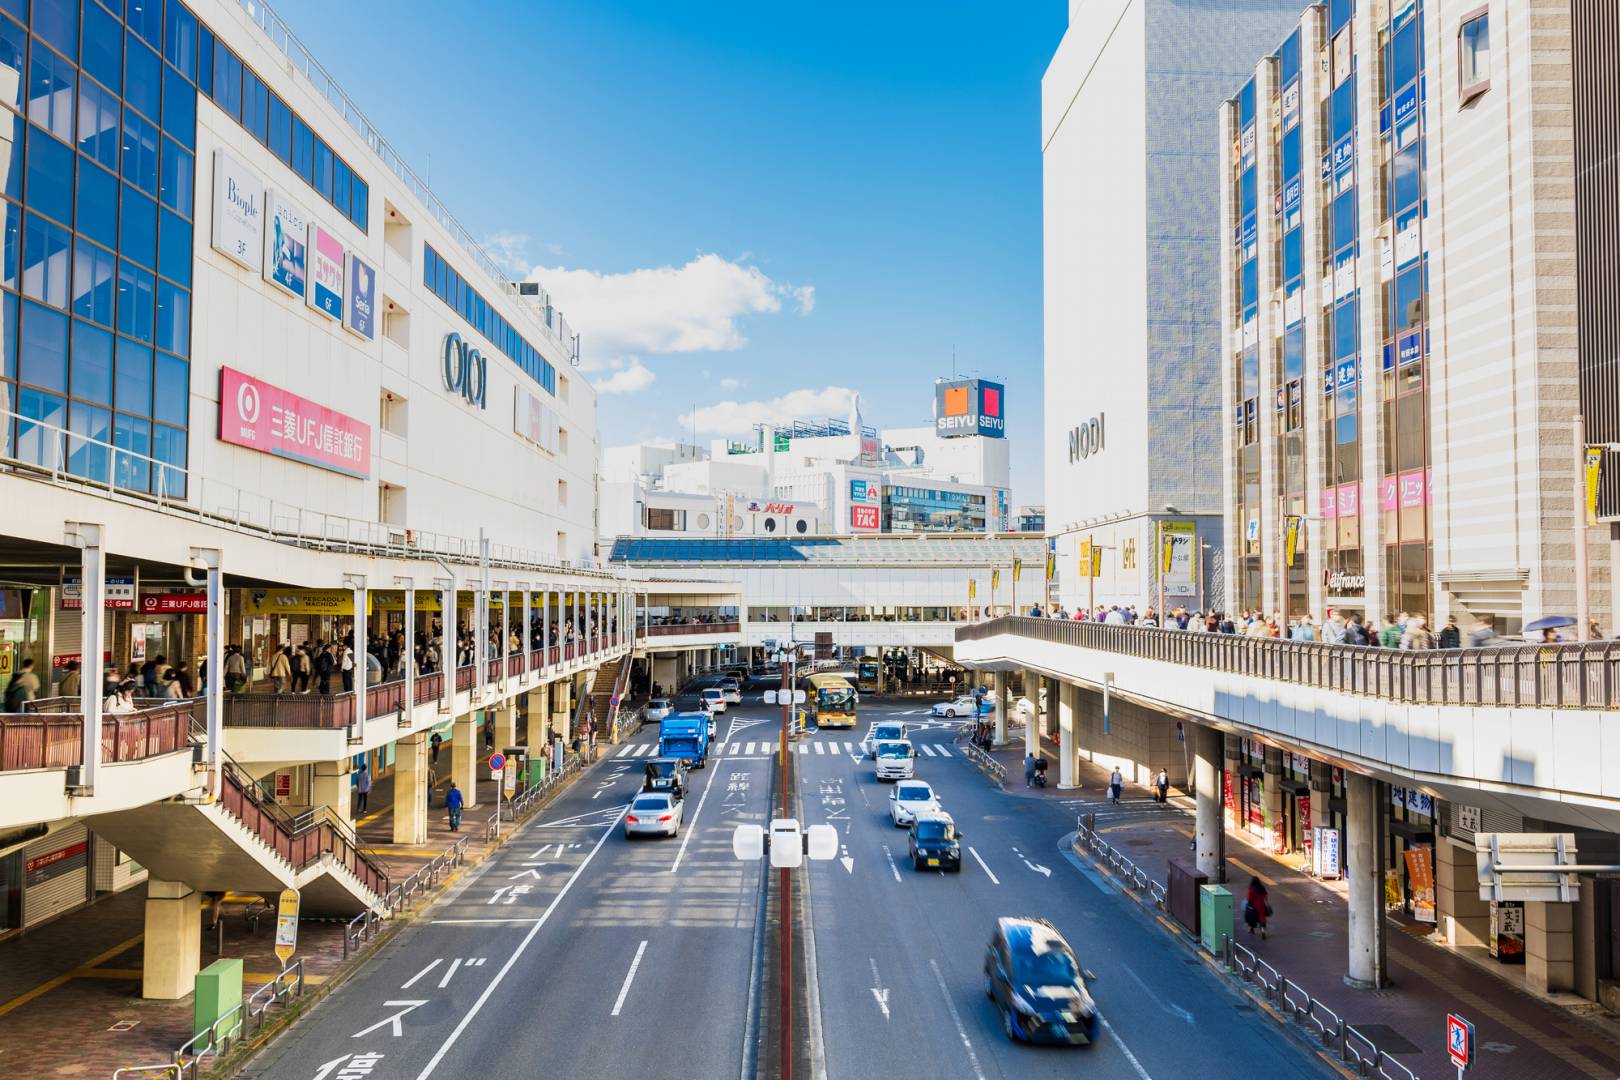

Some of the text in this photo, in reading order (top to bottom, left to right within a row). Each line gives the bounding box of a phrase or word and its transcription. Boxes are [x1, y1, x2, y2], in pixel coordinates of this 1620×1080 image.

[228, 176, 258, 217] Biople
[238, 239, 247, 256] 3F
[355, 295, 370, 316] Seria
[937, 414, 976, 430] SEIYU
[979, 415, 1004, 430] SEIYU
[271, 404, 364, 463] 三菱UFJ信託銀行
[1068, 411, 1105, 465] MODI
[1327, 489, 1356, 509] エミナ
[856, 514, 876, 527] TAC
